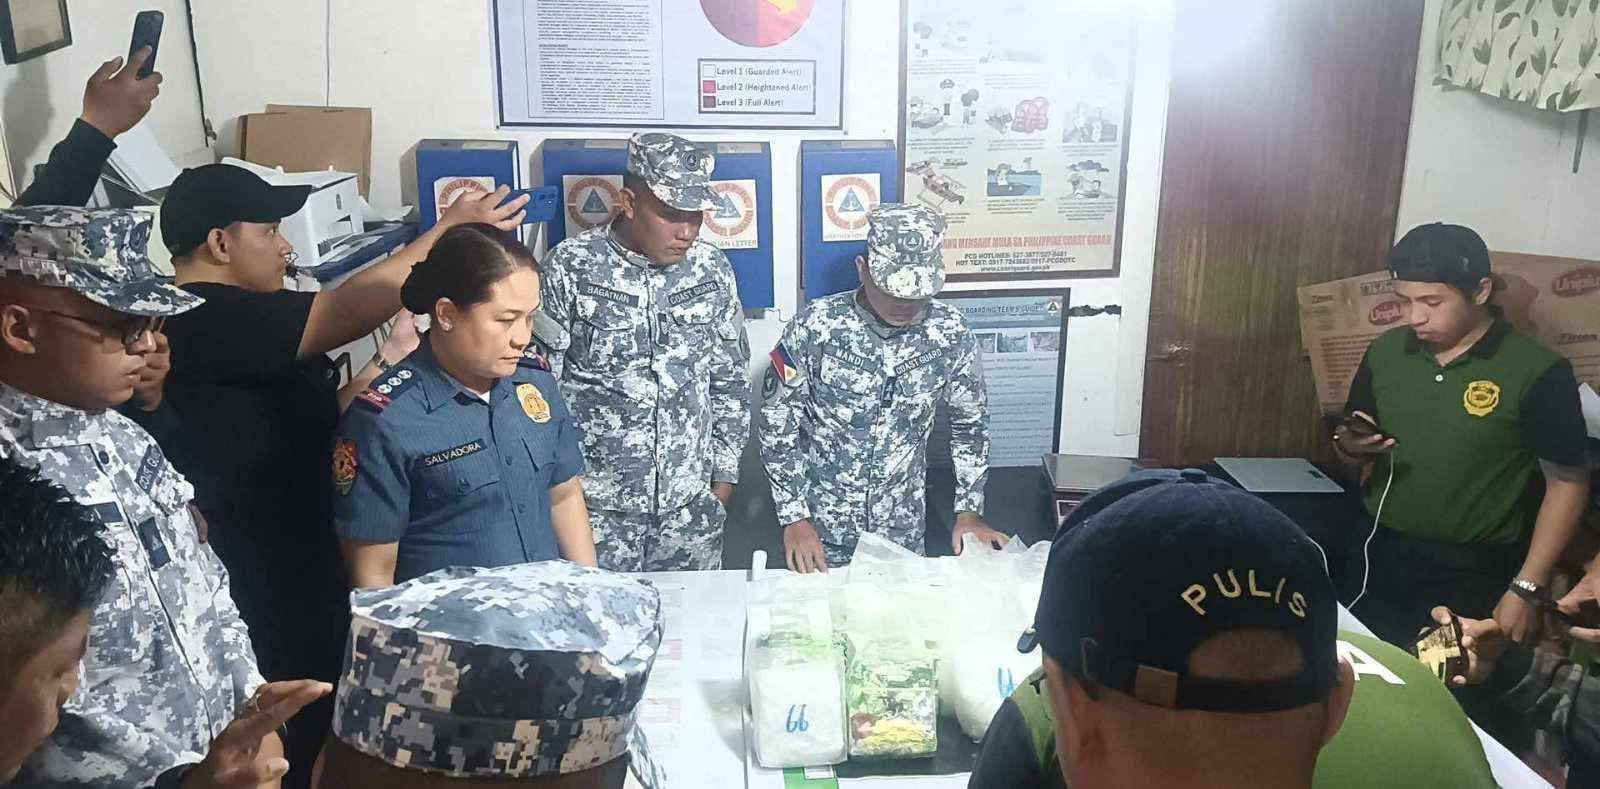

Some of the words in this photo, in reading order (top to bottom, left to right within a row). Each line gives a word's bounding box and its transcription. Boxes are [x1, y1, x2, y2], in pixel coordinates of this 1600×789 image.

[716, 67, 737, 76] Level
[738, 67, 743, 76] 1
[745, 67, 780, 77] (Guarded
[717, 82, 737, 91] Level
[739, 82, 743, 91] 2
[717, 98, 737, 107] Level
[739, 98, 743, 106] 3
[670, 292, 692, 305] COAST
[693, 282, 717, 295] GUARD
[895, 359, 920, 375] COAST
[919, 348, 943, 365] GUARD
[424, 442, 481, 466] SALVADORA
[1180, 568, 1307, 618] PULIS
